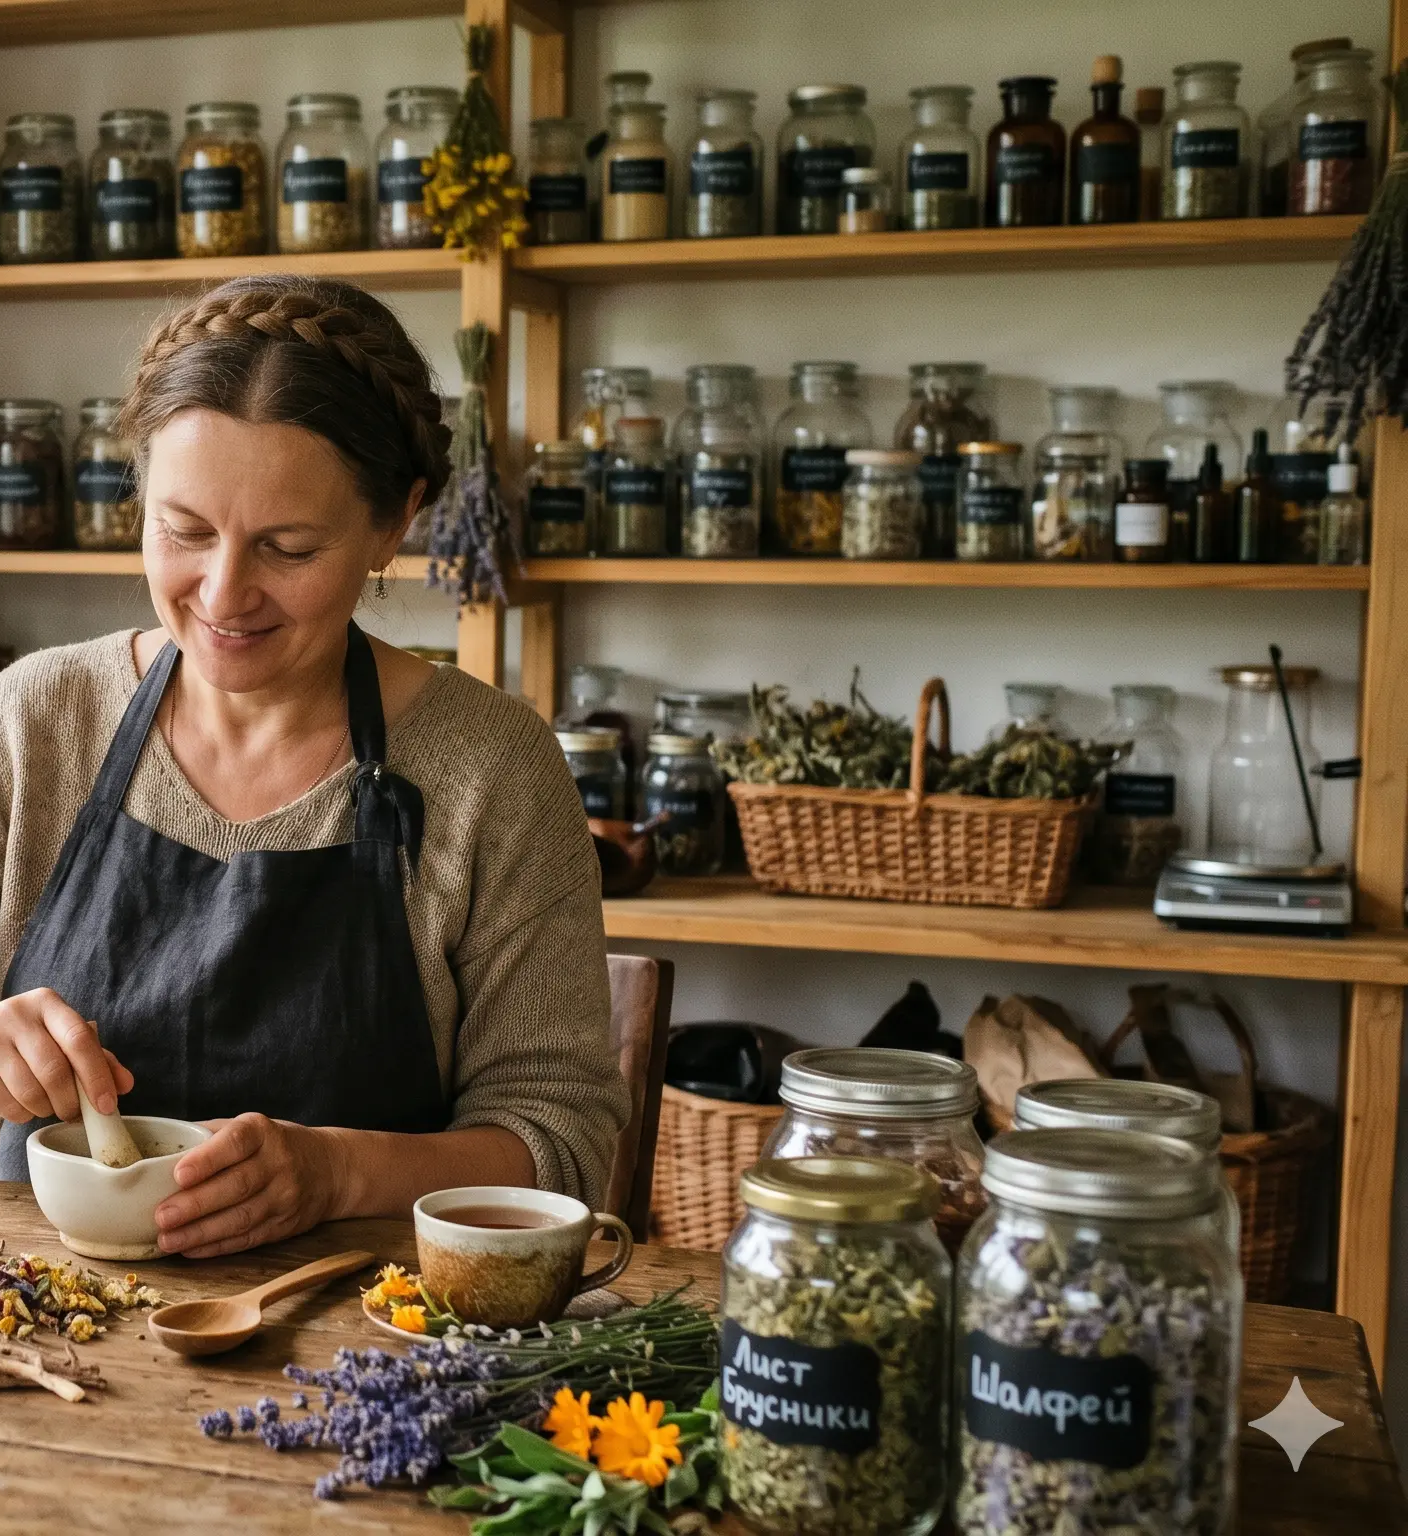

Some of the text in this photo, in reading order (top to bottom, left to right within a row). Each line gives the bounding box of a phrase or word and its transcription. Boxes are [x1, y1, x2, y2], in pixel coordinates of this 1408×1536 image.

[732, 1335, 813, 1387] Лист
[723, 1365, 871, 1428] Брусники
[971, 1353, 1132, 1435] Шалфей
